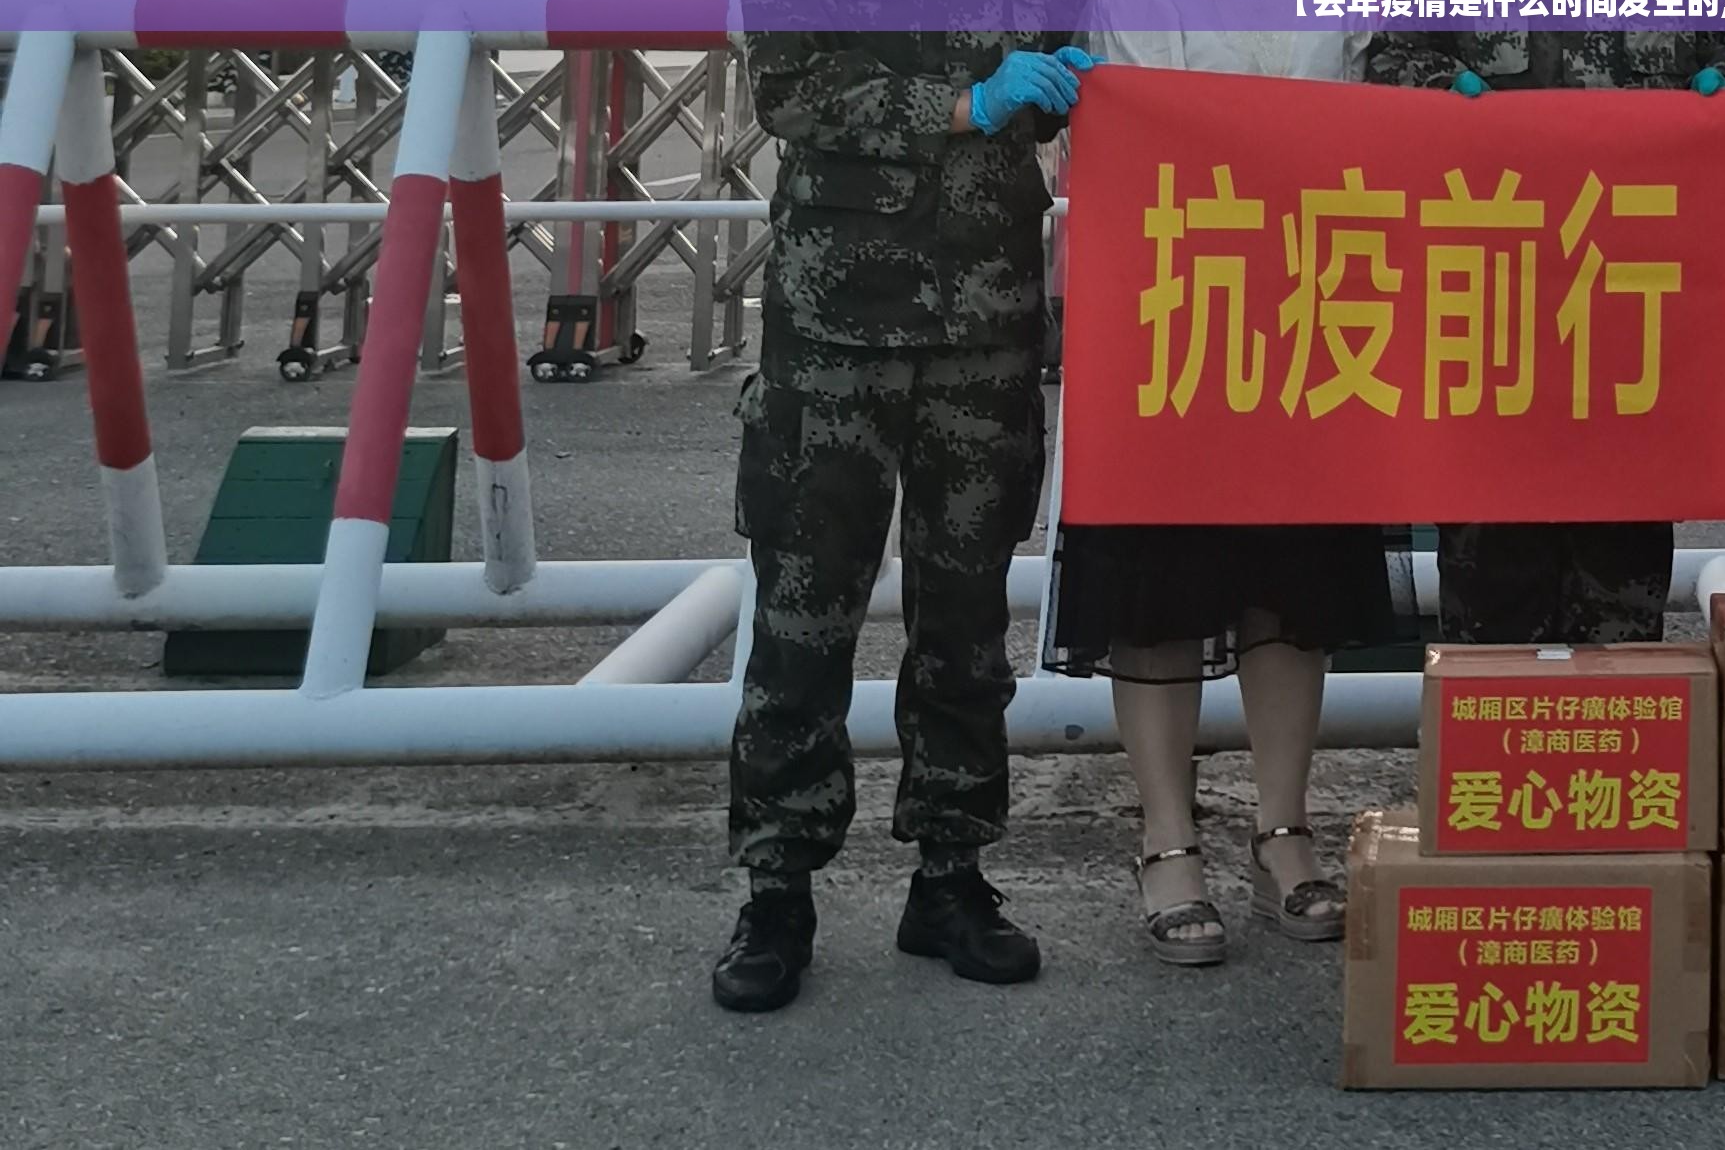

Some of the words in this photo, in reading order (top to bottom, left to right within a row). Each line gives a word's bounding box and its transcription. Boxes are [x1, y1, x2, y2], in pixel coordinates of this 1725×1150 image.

[1138, 162, 1682, 421] 抗疫前行
[1452, 697, 1680, 720] 城厢区片仔癀体验馆
[1447, 769, 1680, 830] 爱心物资
[1407, 907, 1640, 930] 城厢区片仔癀体验馆
[1403, 981, 1639, 1044] 爱心物资
